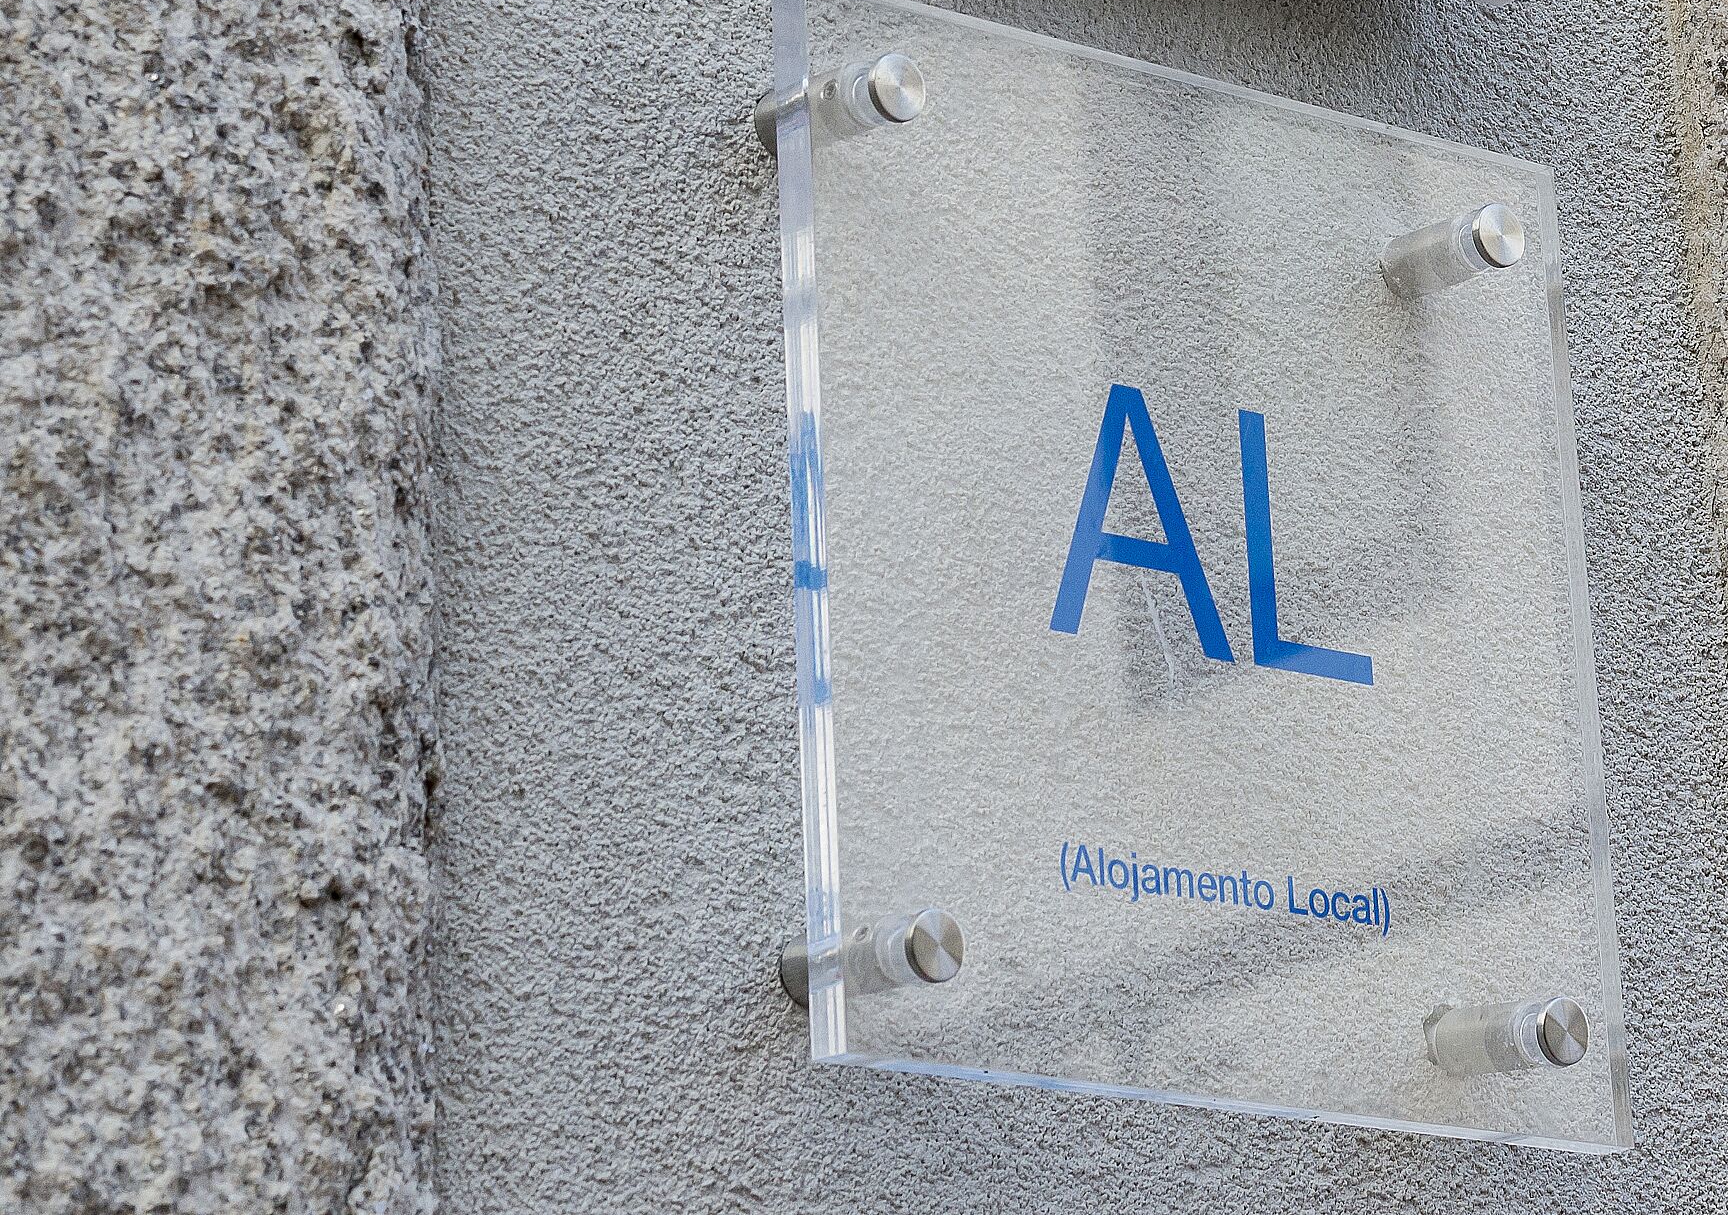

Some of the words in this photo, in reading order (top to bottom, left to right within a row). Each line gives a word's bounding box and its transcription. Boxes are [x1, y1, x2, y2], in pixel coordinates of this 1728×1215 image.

[1049, 384, 1375, 687] AL
[1059, 841, 1276, 912] (Alojamento
[1286, 874, 1391, 939] Local)
